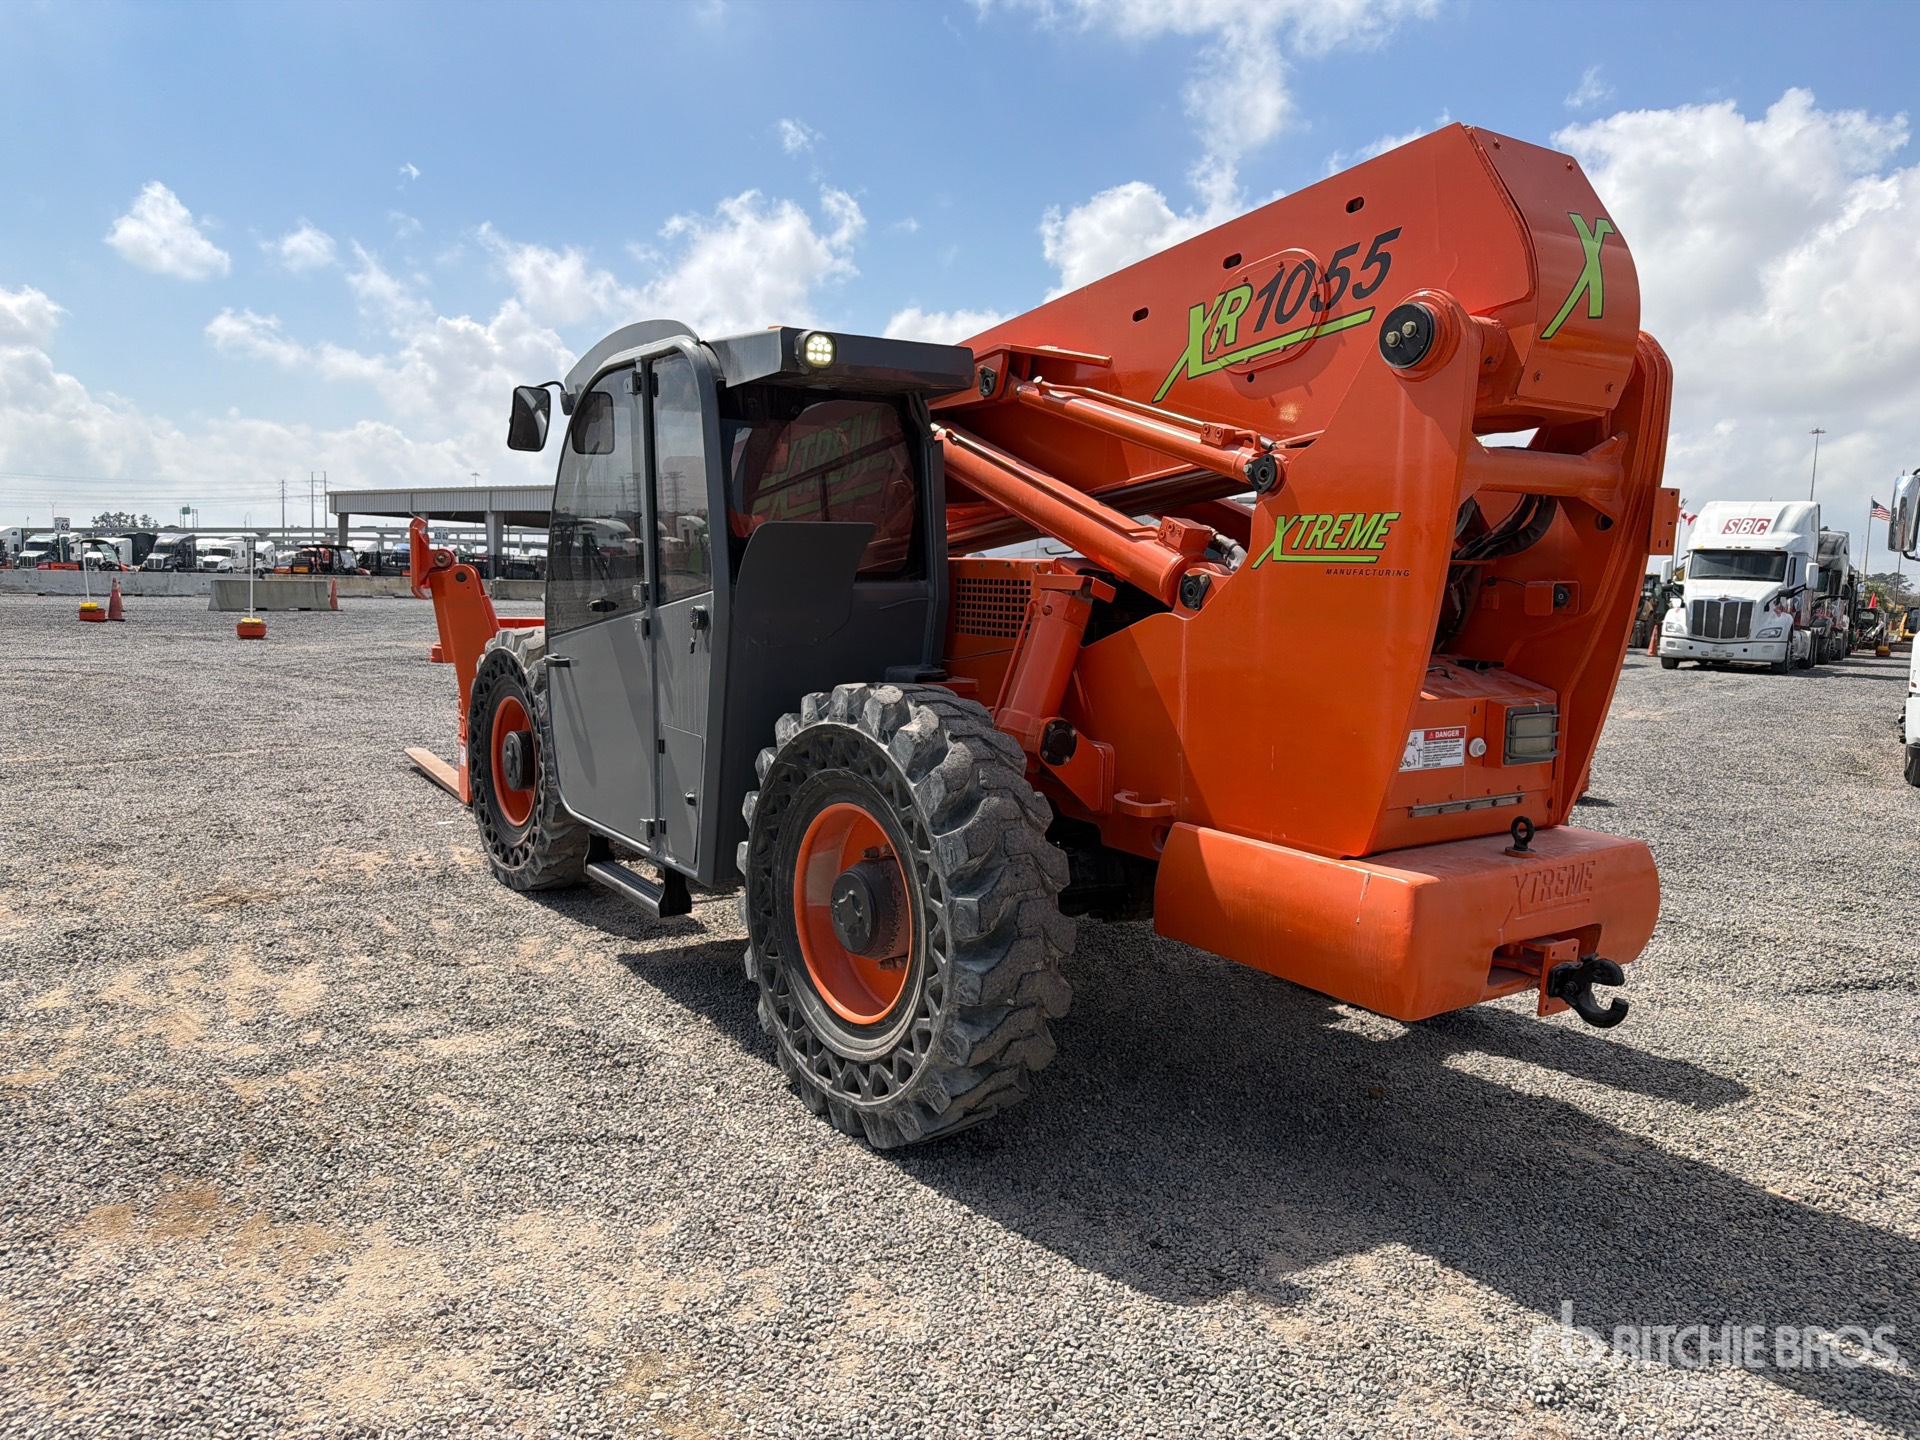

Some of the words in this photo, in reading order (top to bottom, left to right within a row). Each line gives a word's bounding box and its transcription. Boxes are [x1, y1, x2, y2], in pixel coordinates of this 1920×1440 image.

[1539, 211, 1616, 340] X
[60, 522, 70, 531] 62
[1722, 518, 1771, 535] SBC
[1251, 512, 1401, 569] XTREME
[1325, 568, 1410, 577] MANUFACTURING
[1434, 729, 1460, 738] DANGER
[1502, 860, 1596, 924] XTREME
